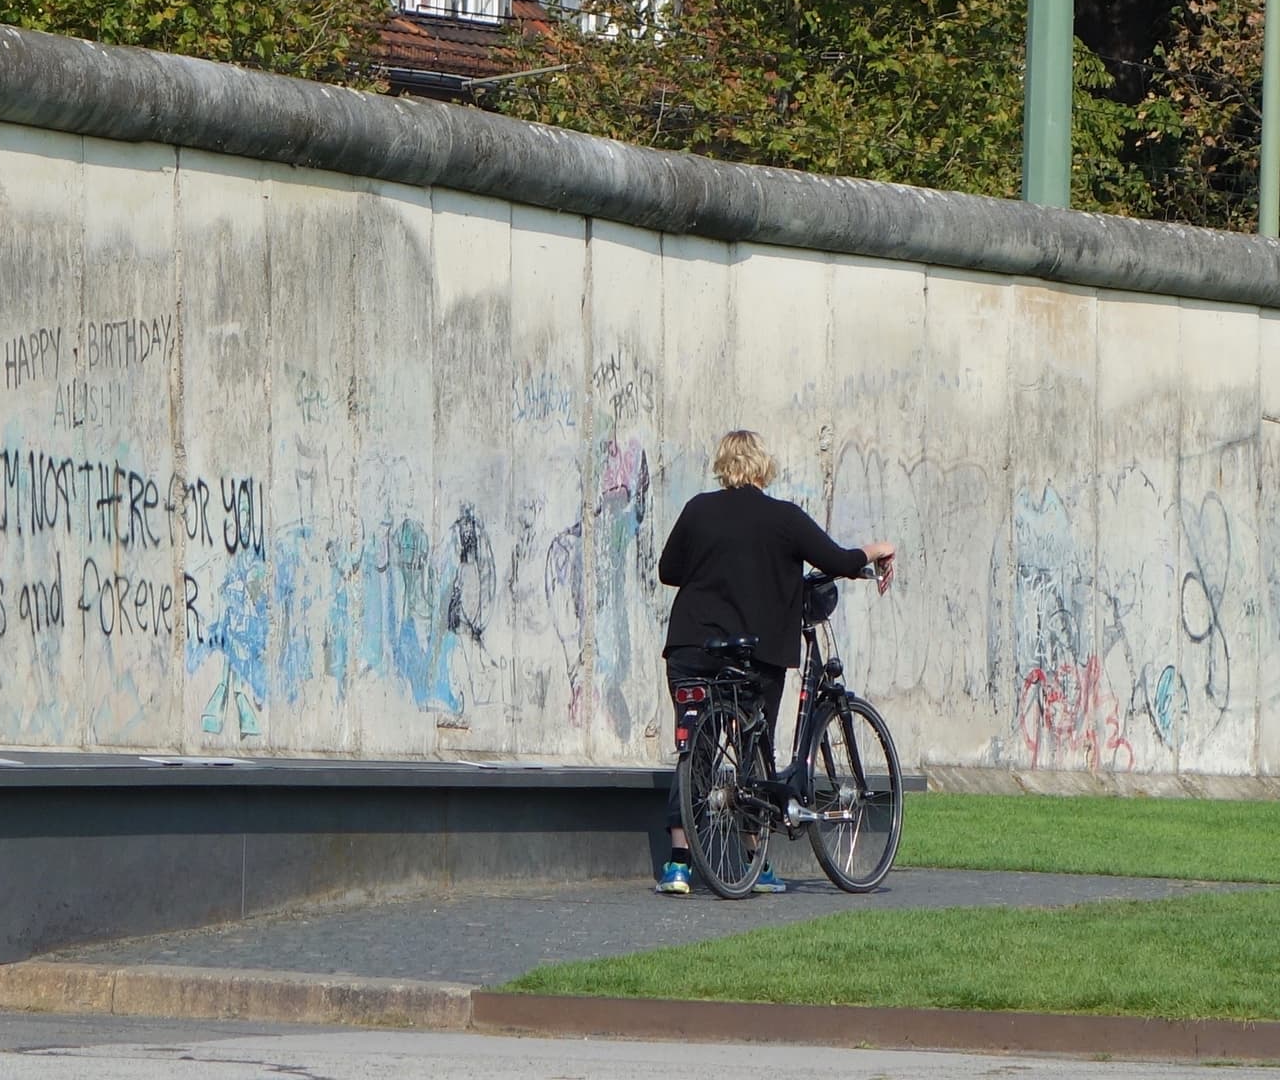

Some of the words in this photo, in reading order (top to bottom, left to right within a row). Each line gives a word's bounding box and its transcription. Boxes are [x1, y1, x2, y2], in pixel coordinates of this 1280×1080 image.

[5, 326, 61, 390] HAPPY
[28, 450, 77, 535] NOT
[78, 458, 160, 551] THERe
[220, 476, 266, 562] YOU
[19, 551, 65, 637] and
